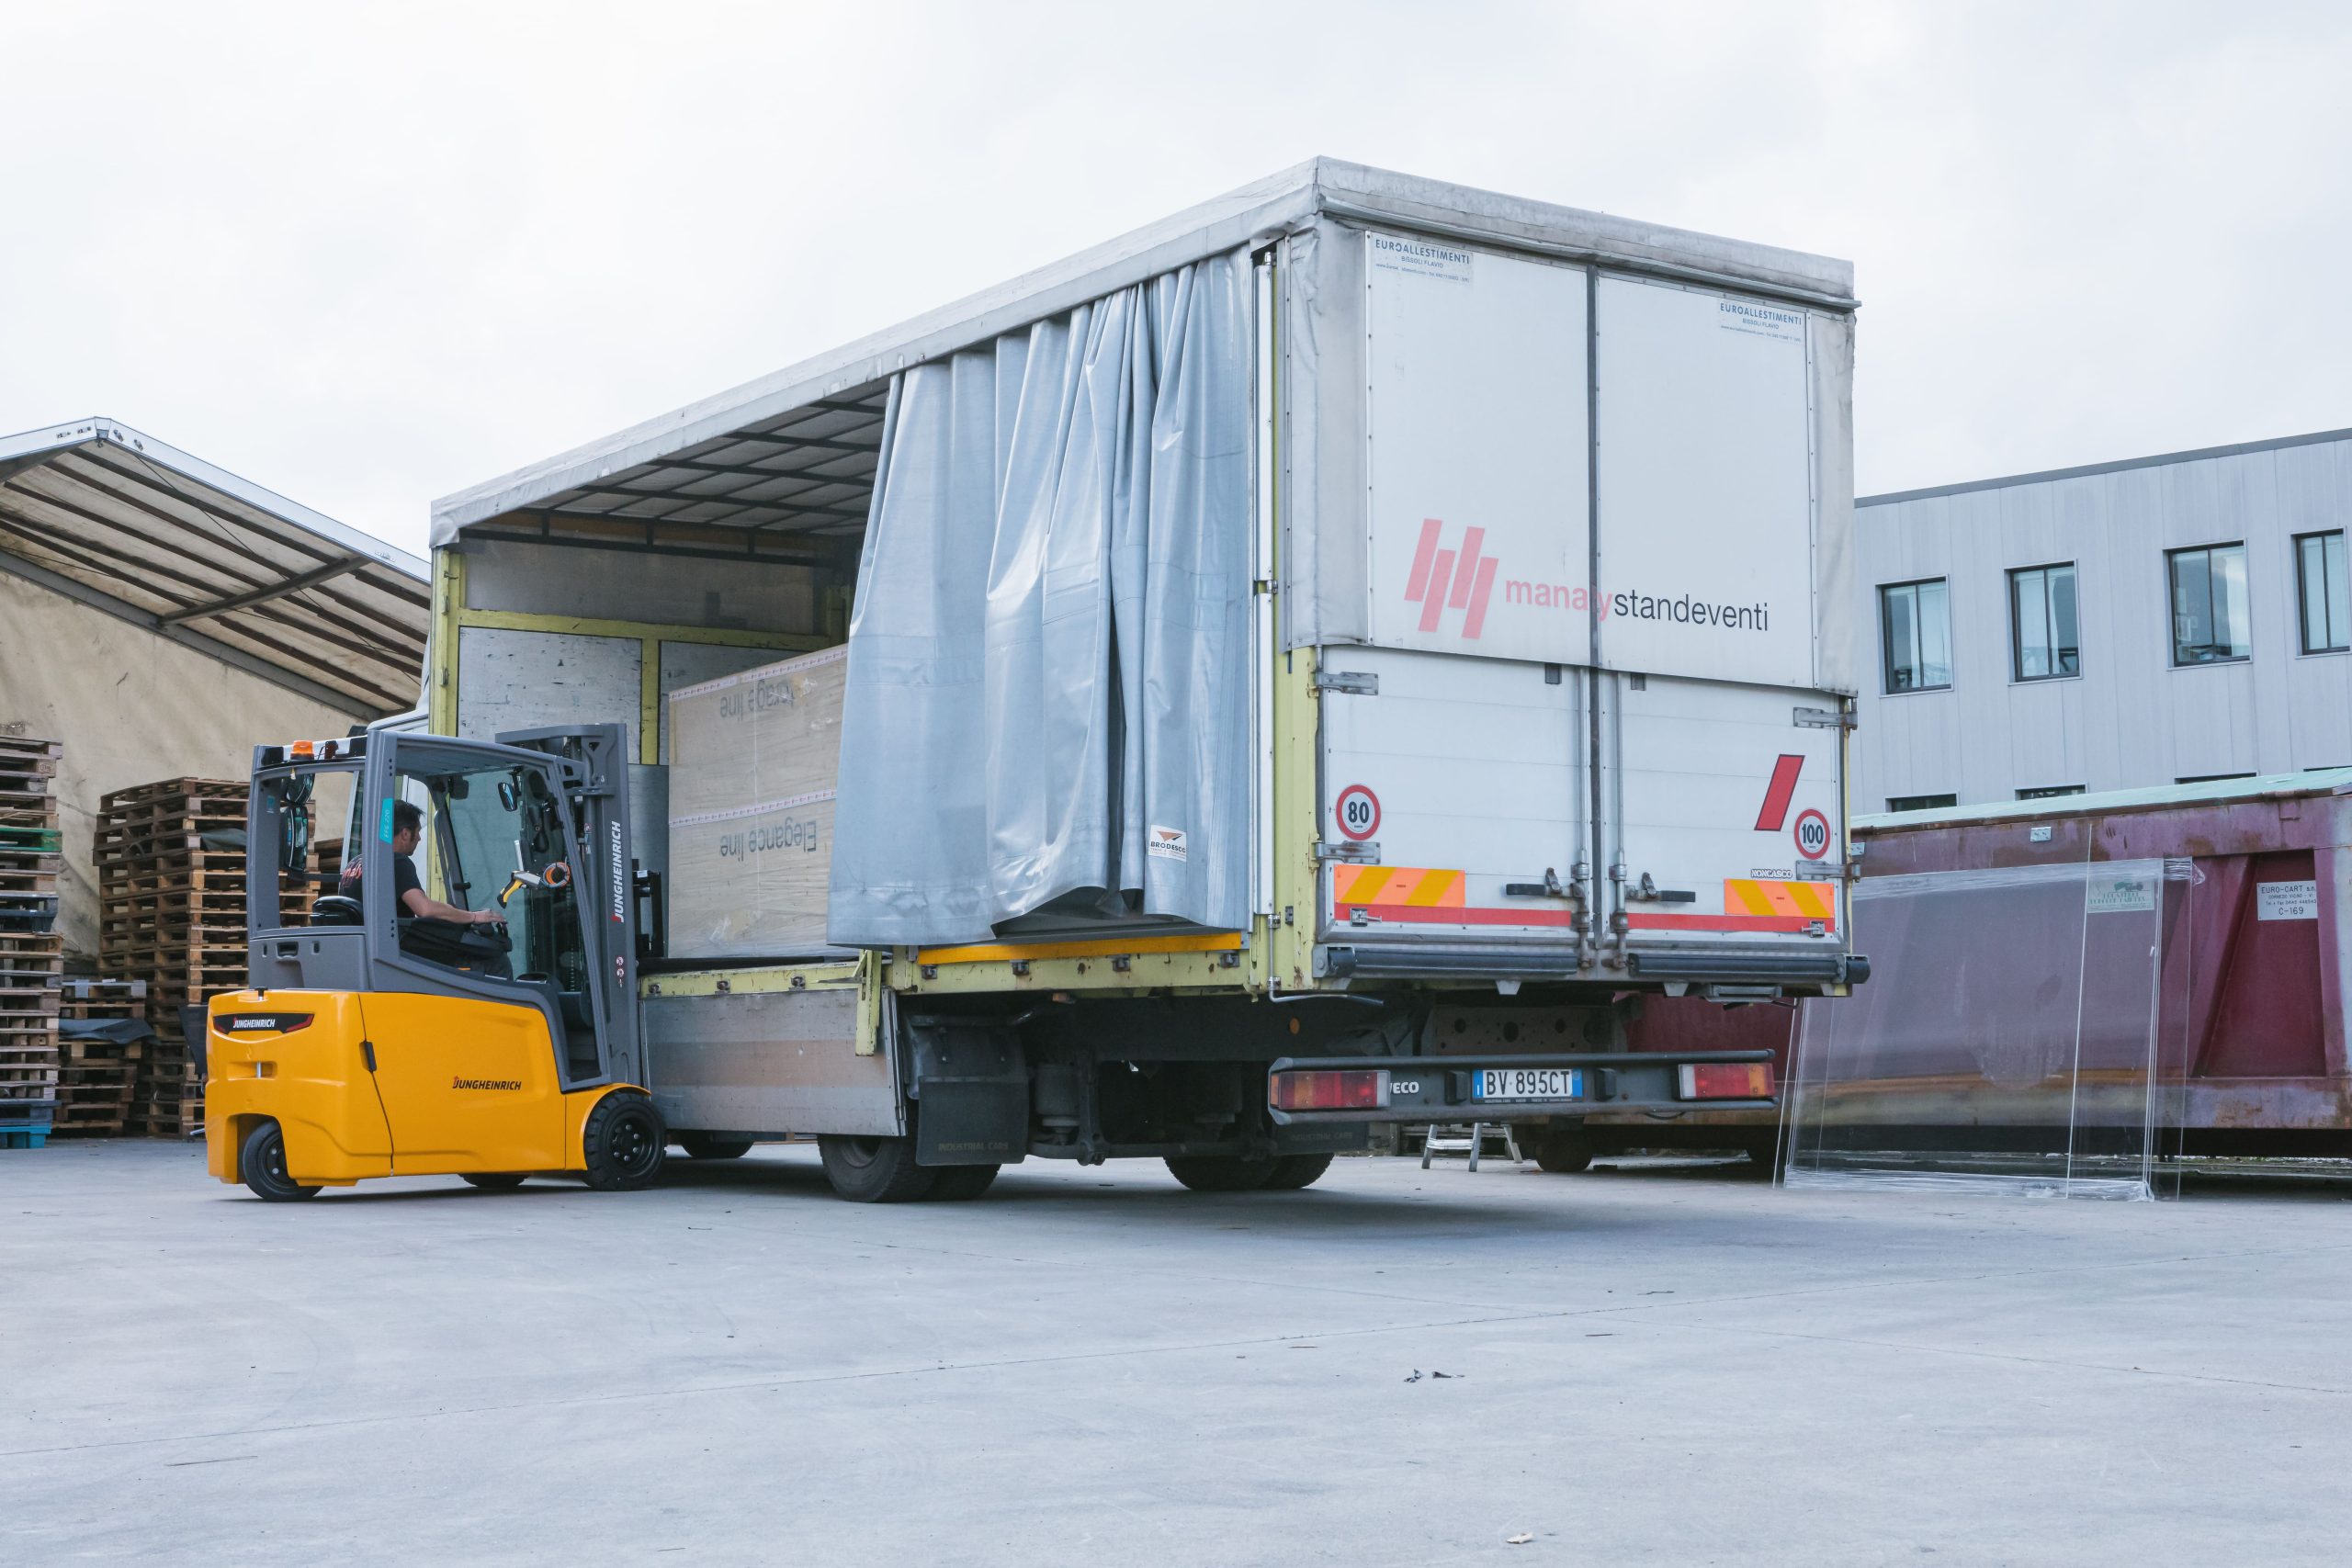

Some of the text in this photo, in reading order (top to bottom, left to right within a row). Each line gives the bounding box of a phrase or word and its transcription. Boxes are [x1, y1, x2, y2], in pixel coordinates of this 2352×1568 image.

[1375, 239, 1470, 265] EUROALLESTIMENTI
[1401, 256, 1443, 268] BISSOLI FLAVIO
[1720, 303, 1802, 325] EUROALLESTIMENTI
[719, 692, 743, 721] line
[1348, 801, 1369, 823] 80
[719, 817, 817, 862] Elegance line
[1802, 823, 1824, 844] 100
[611, 820, 625, 923] JUNGHEINRICH
[2261, 885, 2303, 894] EURO-CART
[2278, 907, 2304, 916] C-169
[232, 1017, 276, 1028] JUNGHEINRICH
[452, 1077, 522, 1090] JUNGHEINRICH
[1389, 1081, 1419, 1094] ECO
[1486, 1070, 1569, 1095] BV 895CT
